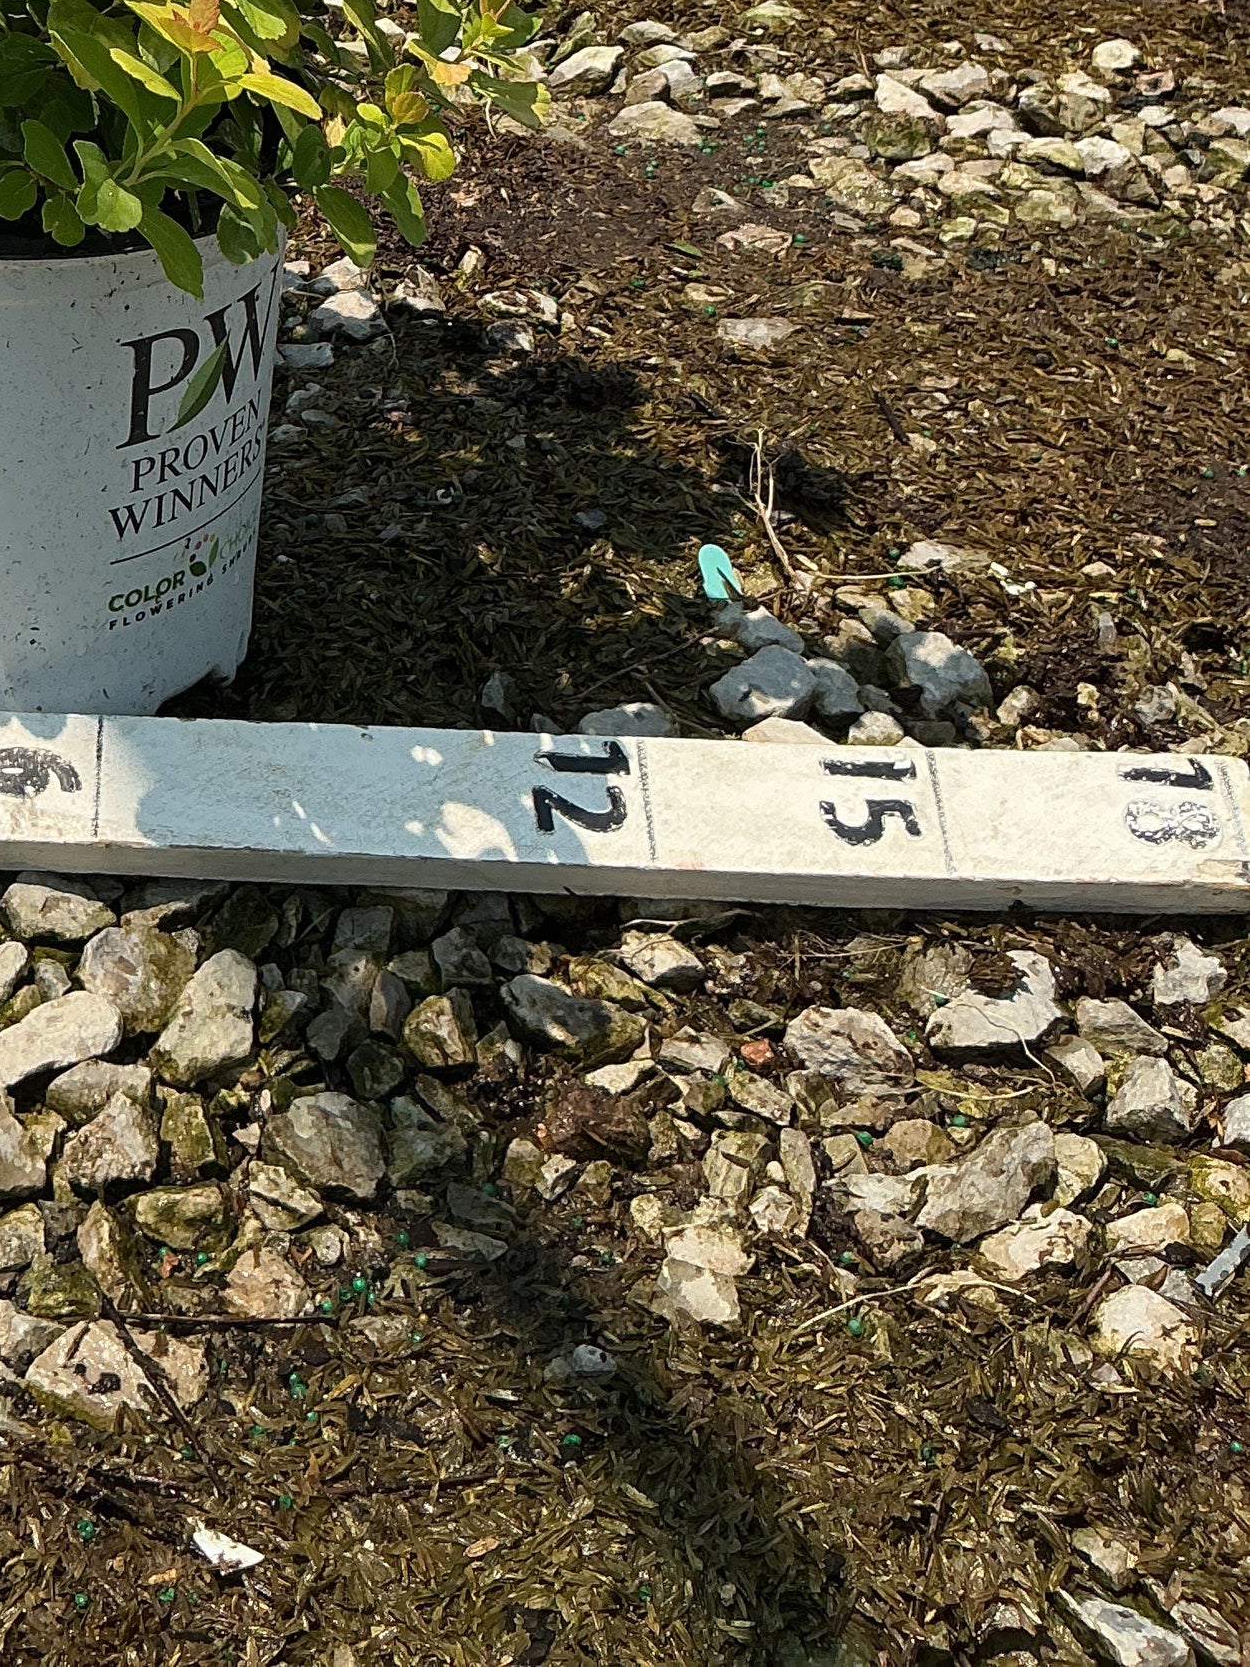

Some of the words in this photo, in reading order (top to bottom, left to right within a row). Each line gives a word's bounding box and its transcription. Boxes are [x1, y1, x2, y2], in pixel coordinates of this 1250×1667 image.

[129, 386, 262, 494] PROVEN
[108, 569, 186, 613] COLOR
[108, 572, 214, 631] FLOWERING
